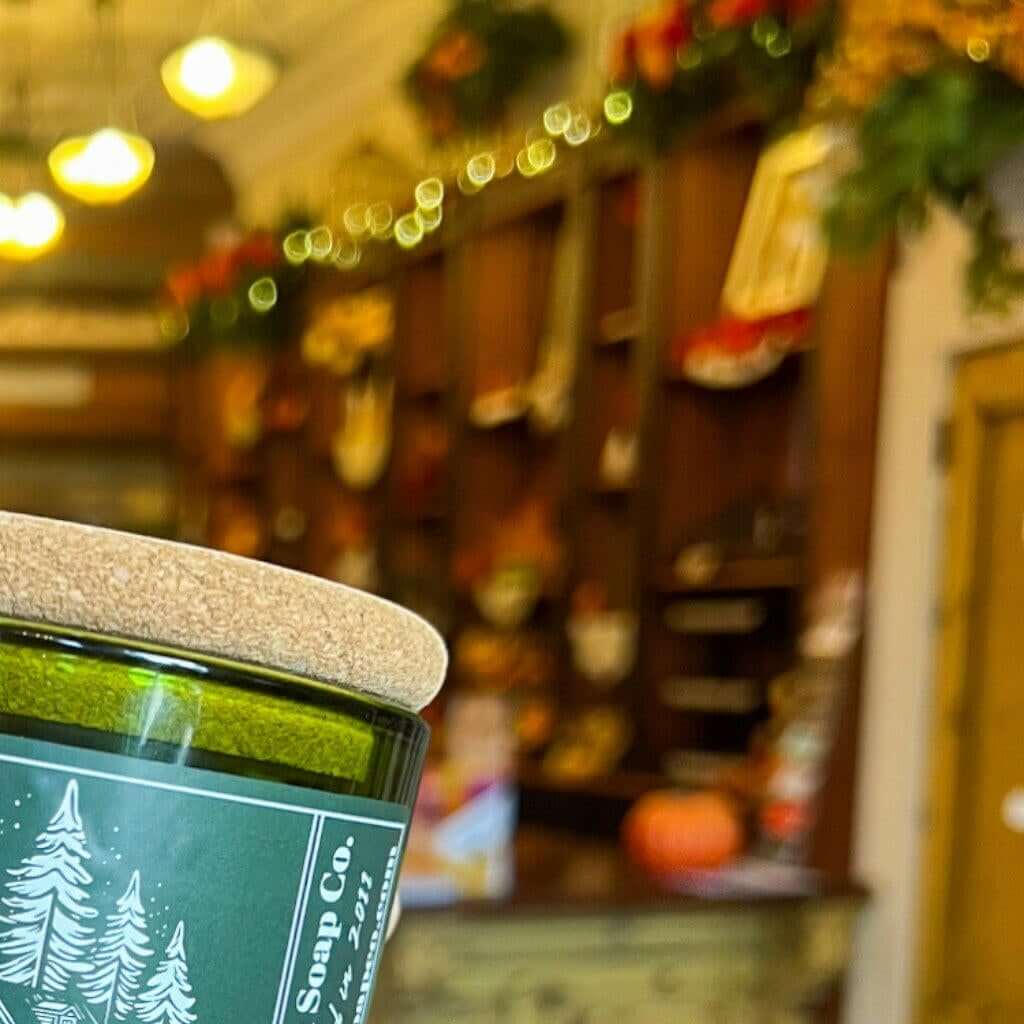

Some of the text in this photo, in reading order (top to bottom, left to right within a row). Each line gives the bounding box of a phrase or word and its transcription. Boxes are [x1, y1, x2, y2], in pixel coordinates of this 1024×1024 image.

[296, 911, 342, 1014] Soap
[320, 835, 355, 903] Co.
[338, 963, 353, 1001] in
